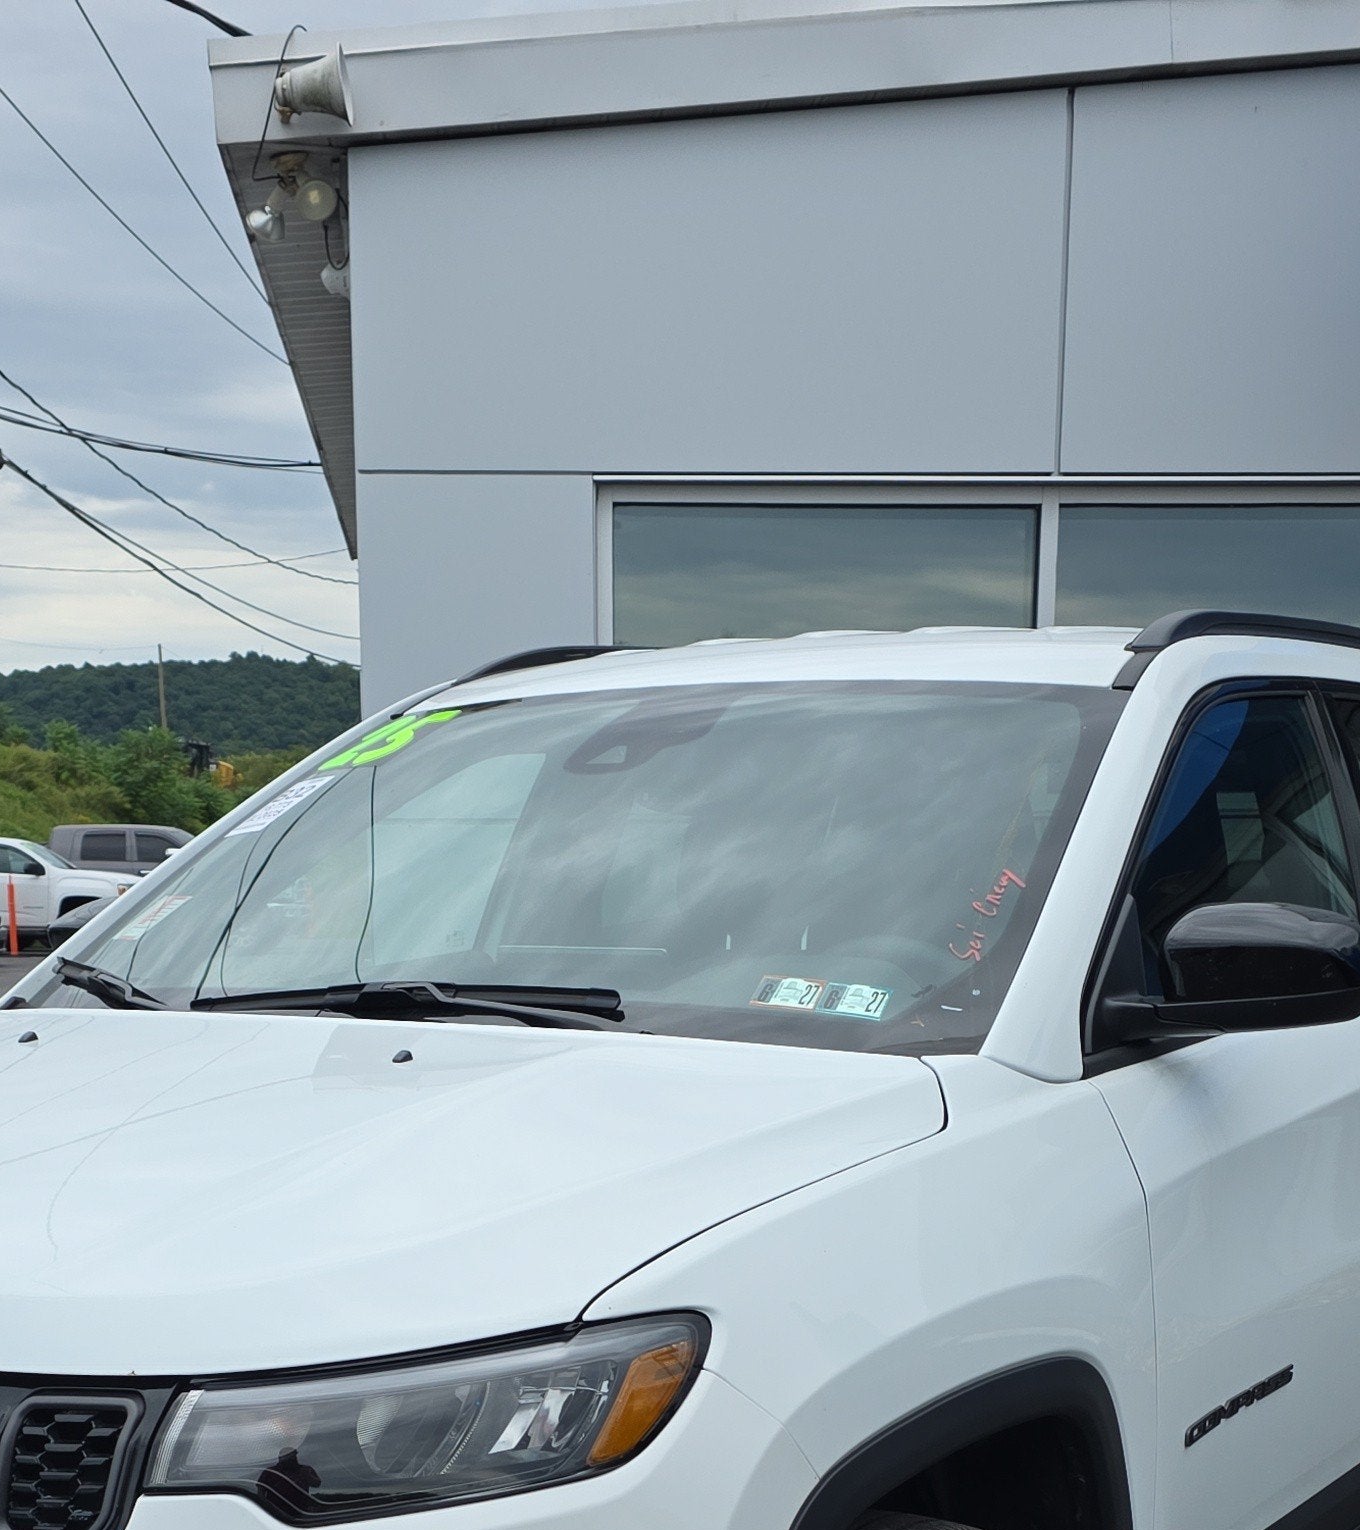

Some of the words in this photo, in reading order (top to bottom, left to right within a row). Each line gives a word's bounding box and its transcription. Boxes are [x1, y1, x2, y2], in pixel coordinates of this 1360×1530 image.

[317, 709, 462, 771] 25
[797, 984, 820, 1006] 27
[864, 991, 887, 1014] 27
